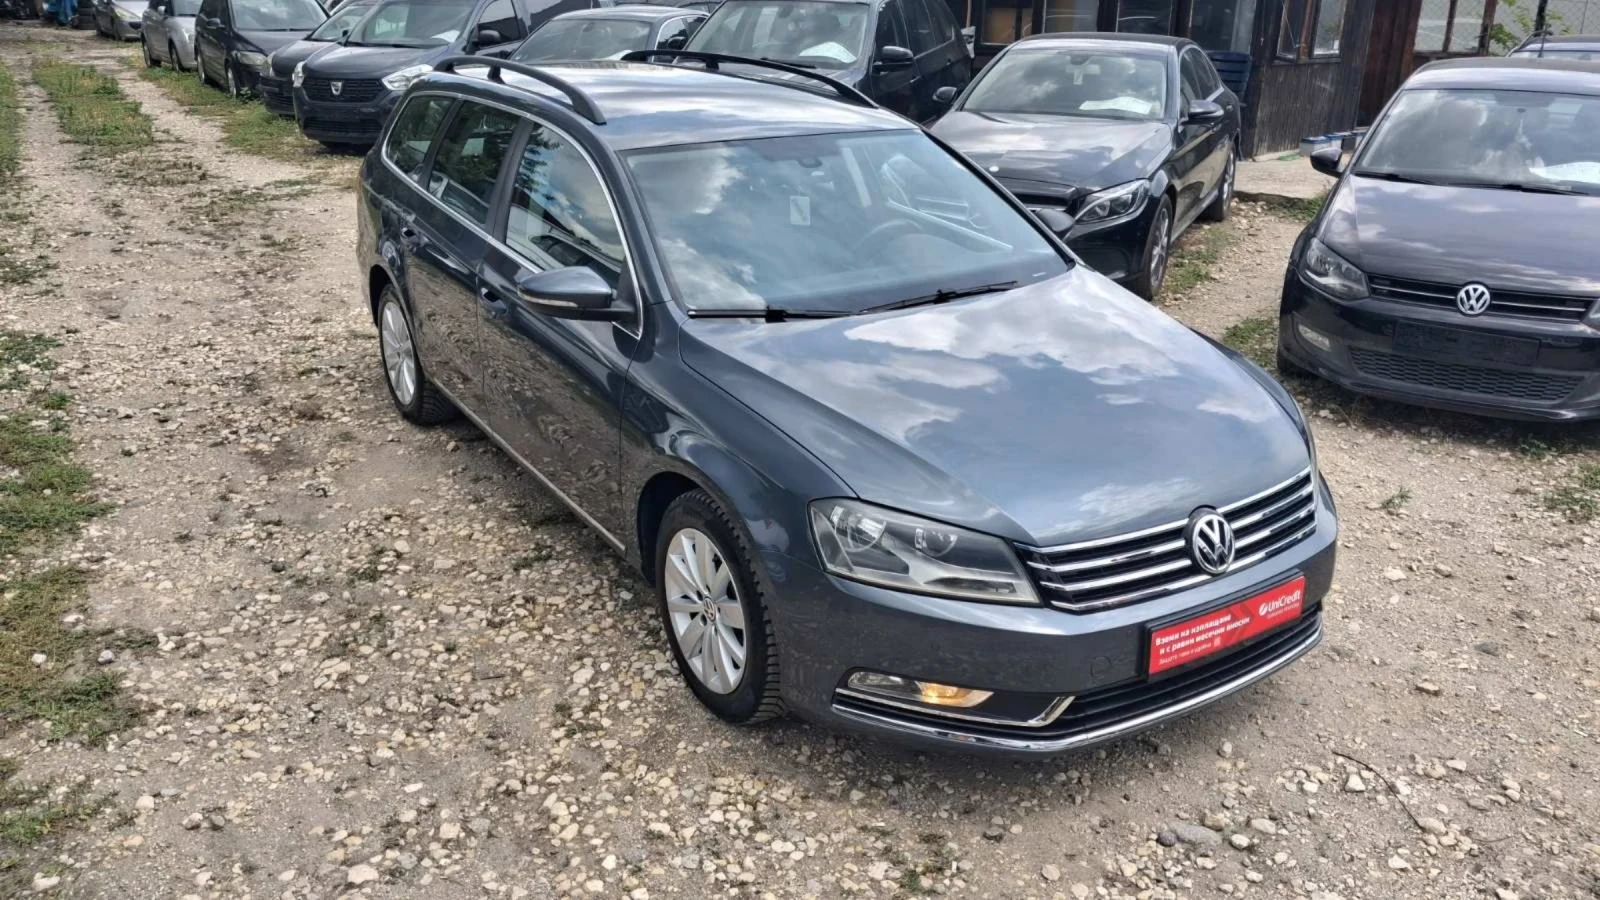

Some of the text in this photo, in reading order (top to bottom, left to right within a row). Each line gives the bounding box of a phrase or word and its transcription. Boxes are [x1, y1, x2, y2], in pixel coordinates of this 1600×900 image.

[1193, 514, 1235, 573] VW
[1267, 590, 1301, 612] UniCredit
[1180, 629, 1190, 638] на
